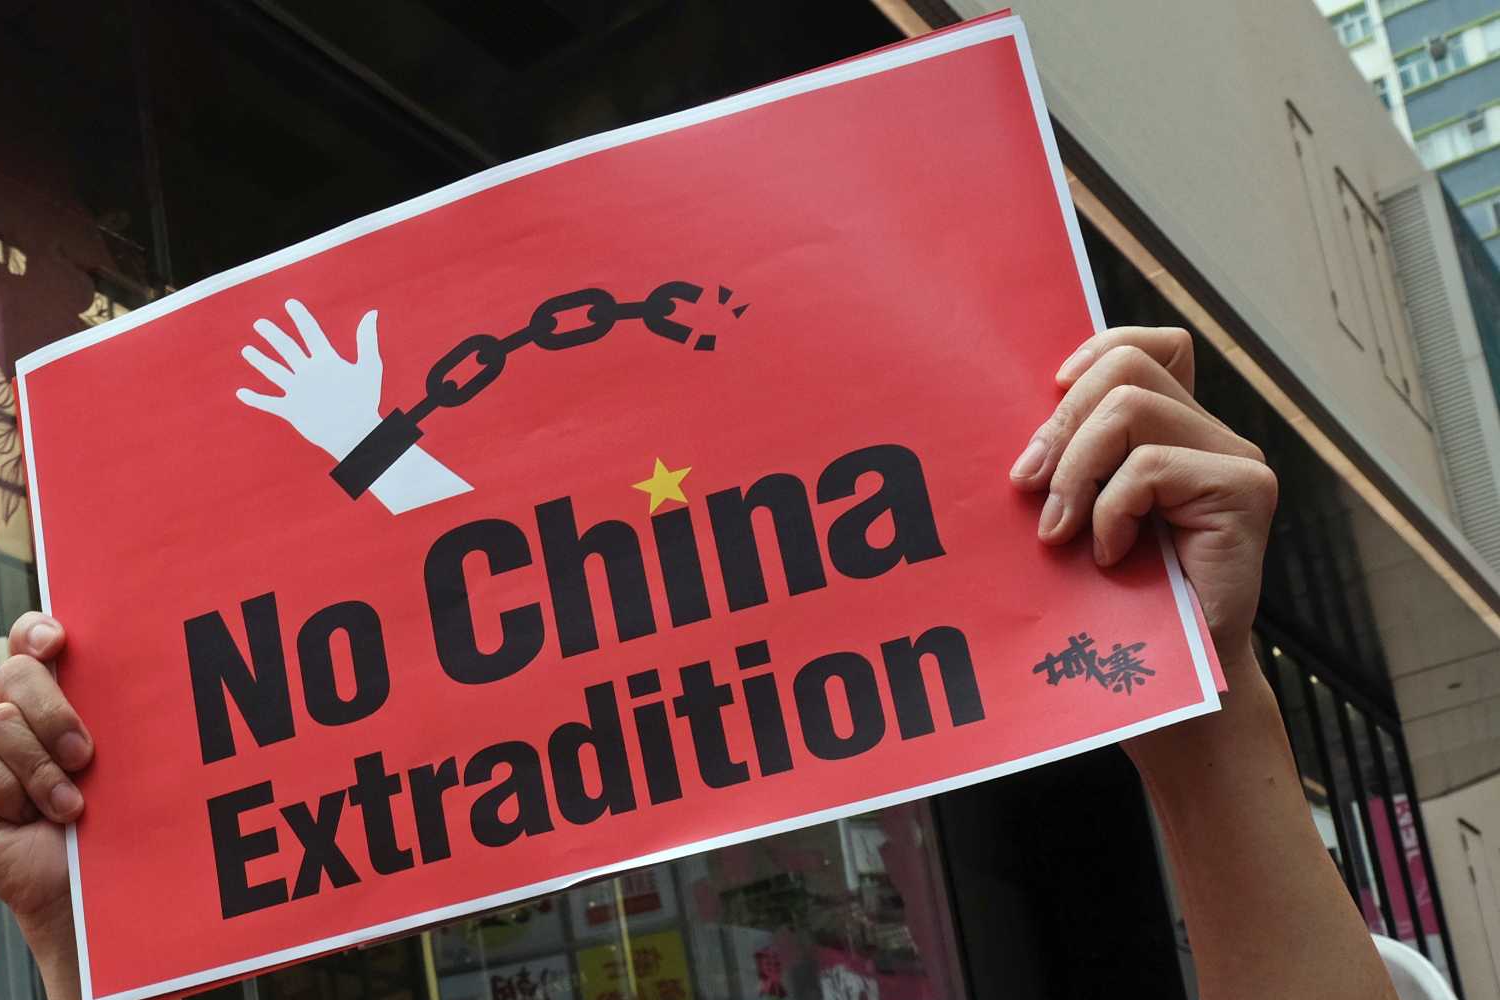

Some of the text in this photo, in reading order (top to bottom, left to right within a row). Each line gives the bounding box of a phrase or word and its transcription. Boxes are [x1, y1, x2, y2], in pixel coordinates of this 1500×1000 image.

[183, 443, 947, 764] No China
[1032, 632, 1156, 696] 城寨
[206, 624, 985, 920] Extradition
